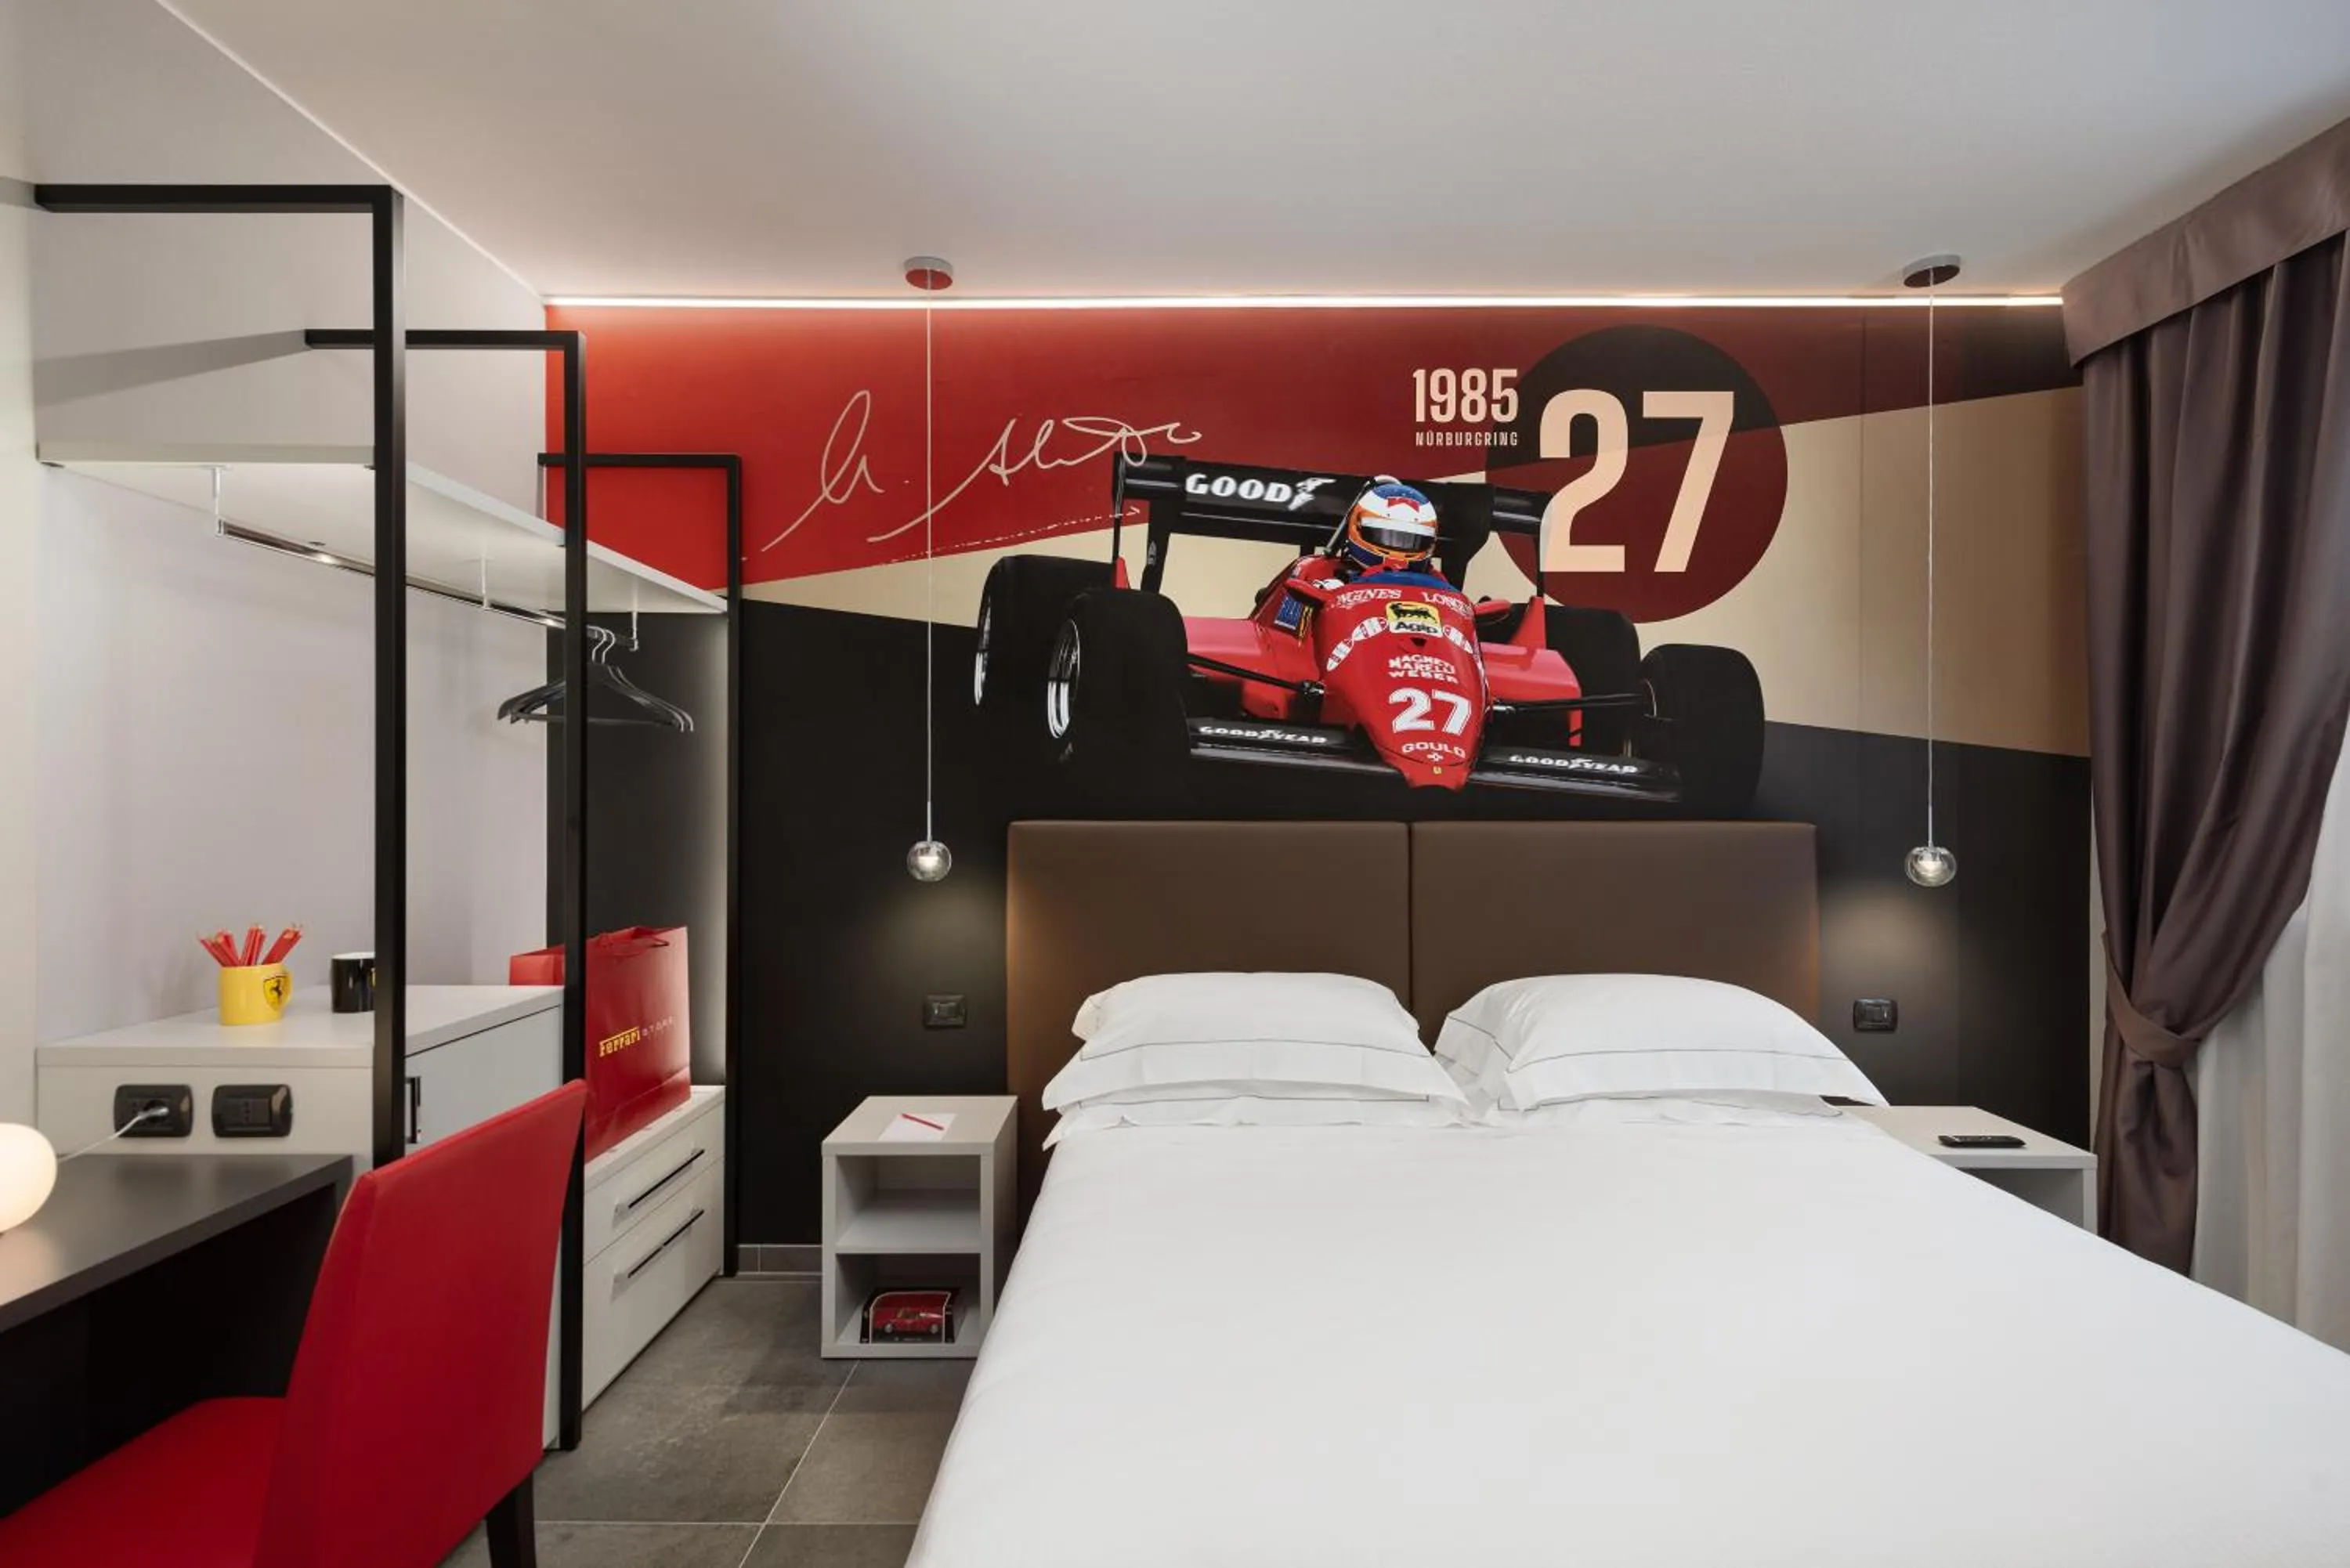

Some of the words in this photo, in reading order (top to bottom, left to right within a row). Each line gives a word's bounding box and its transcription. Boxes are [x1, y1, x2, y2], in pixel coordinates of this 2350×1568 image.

[1412, 368, 1519, 424] 1985
[1539, 388, 1735, 573] 27
[1389, 687, 1472, 736] 27
[1199, 726, 1328, 743] GOODYEAR
[1402, 742, 1466, 758] GOULD
[1509, 754, 1638, 773] GOODYEAR
[599, 1026, 640, 1057] Ferrari
